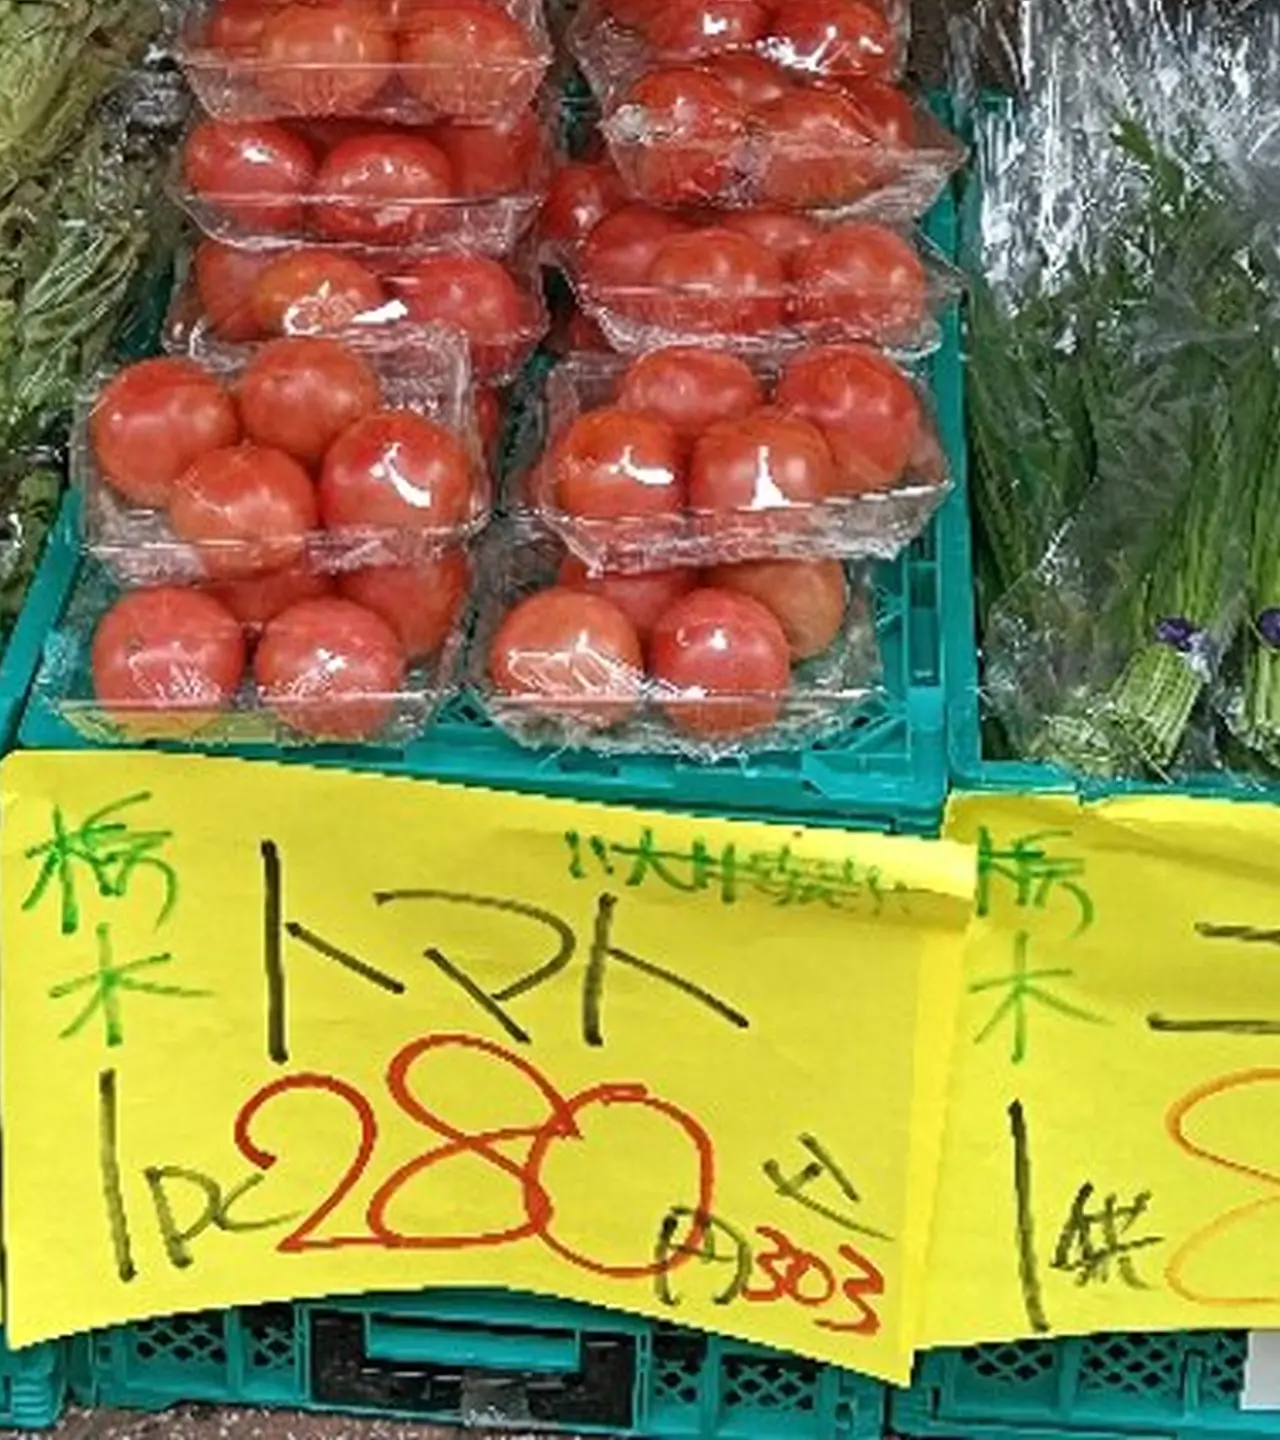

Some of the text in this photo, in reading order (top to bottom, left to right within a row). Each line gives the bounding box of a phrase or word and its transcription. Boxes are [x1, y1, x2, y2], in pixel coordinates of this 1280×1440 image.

[23, 791, 212, 1046] 栃木
[260, 840, 749, 1063] トマト
[969, 825, 1112, 1065] 栃木
